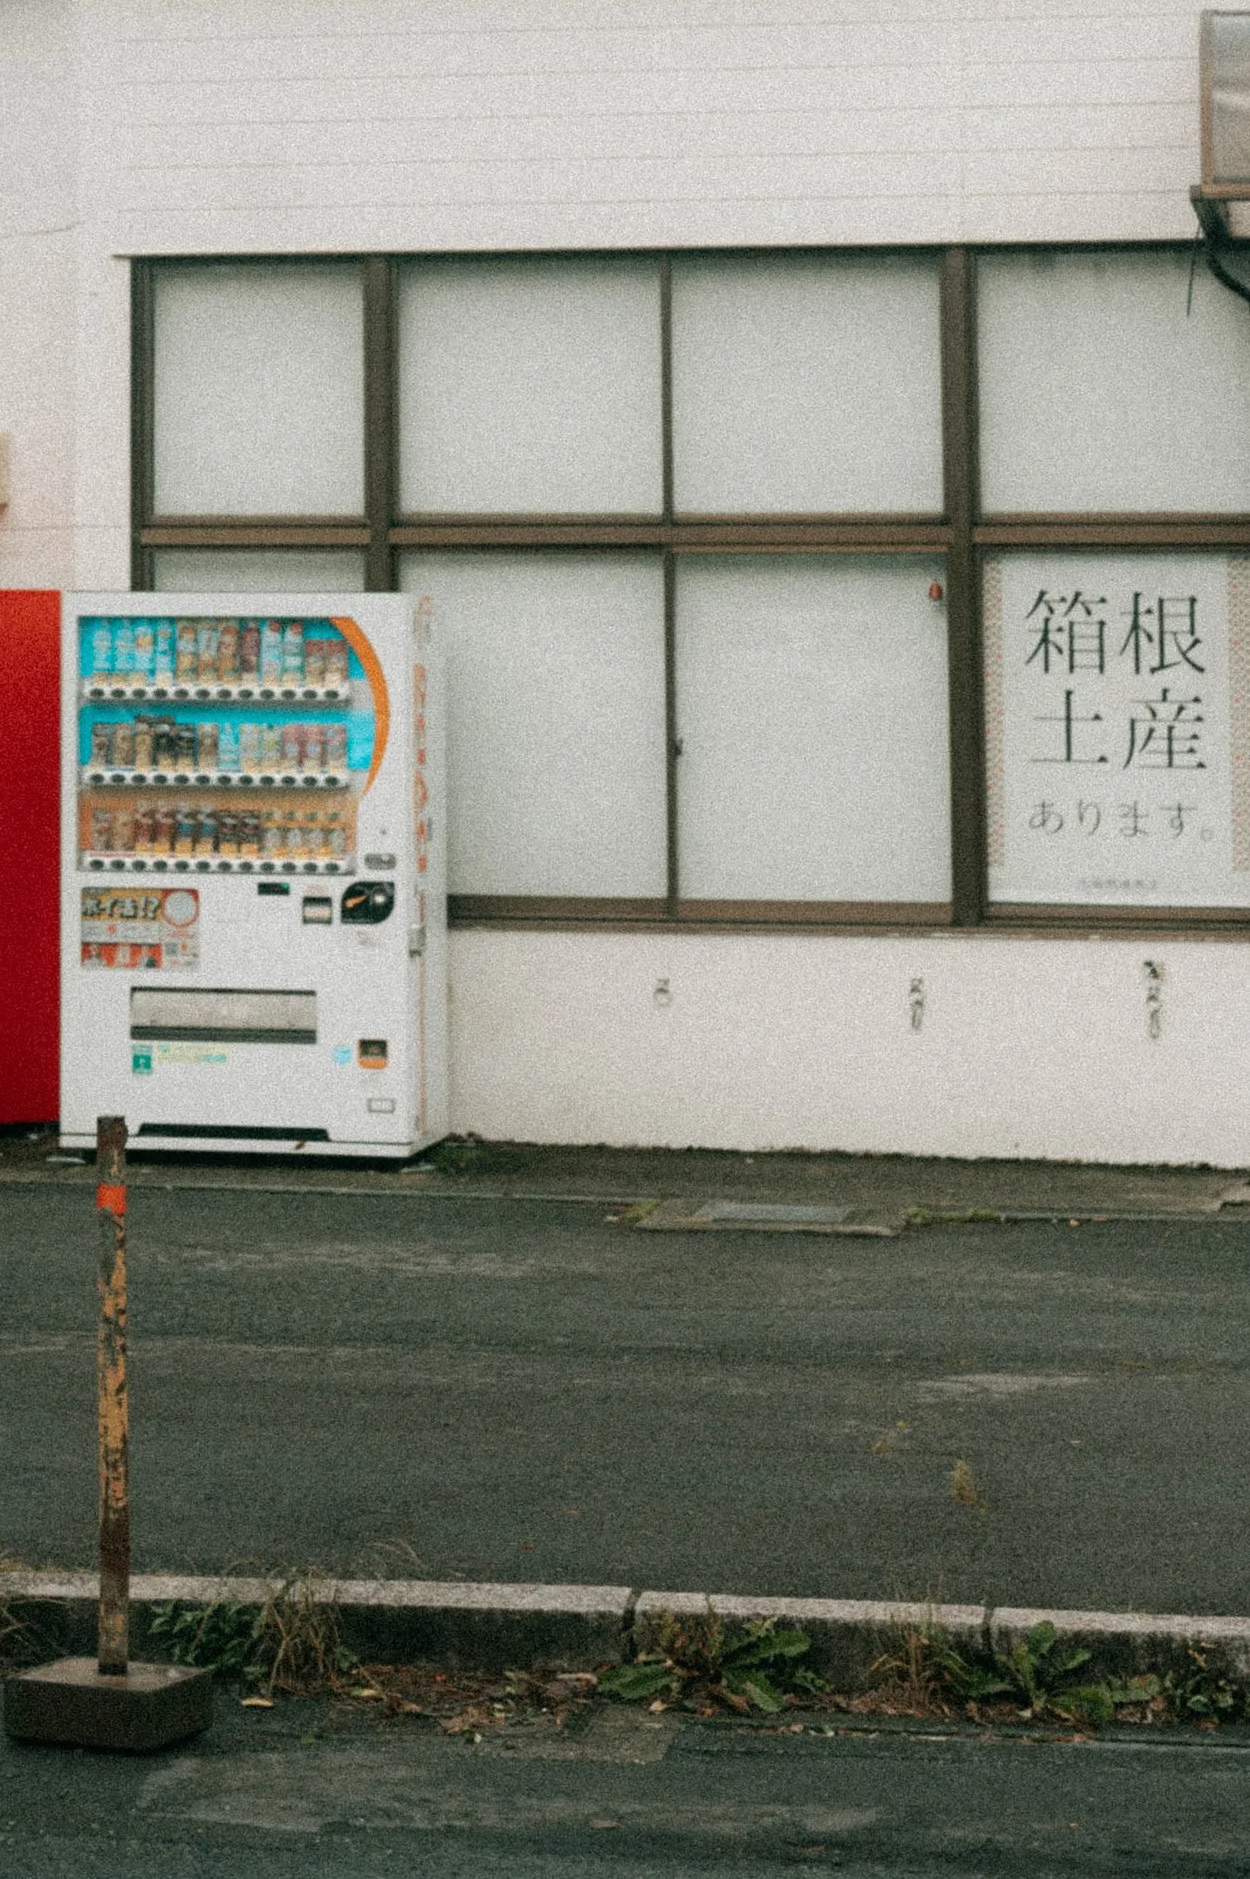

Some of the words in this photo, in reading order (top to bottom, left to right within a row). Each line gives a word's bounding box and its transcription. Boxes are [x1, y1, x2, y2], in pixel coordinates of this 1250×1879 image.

[1025, 589, 1206, 675] 箱根
[1029, 687, 1207, 770] 土産
[1028, 799, 1214, 842] あります。
